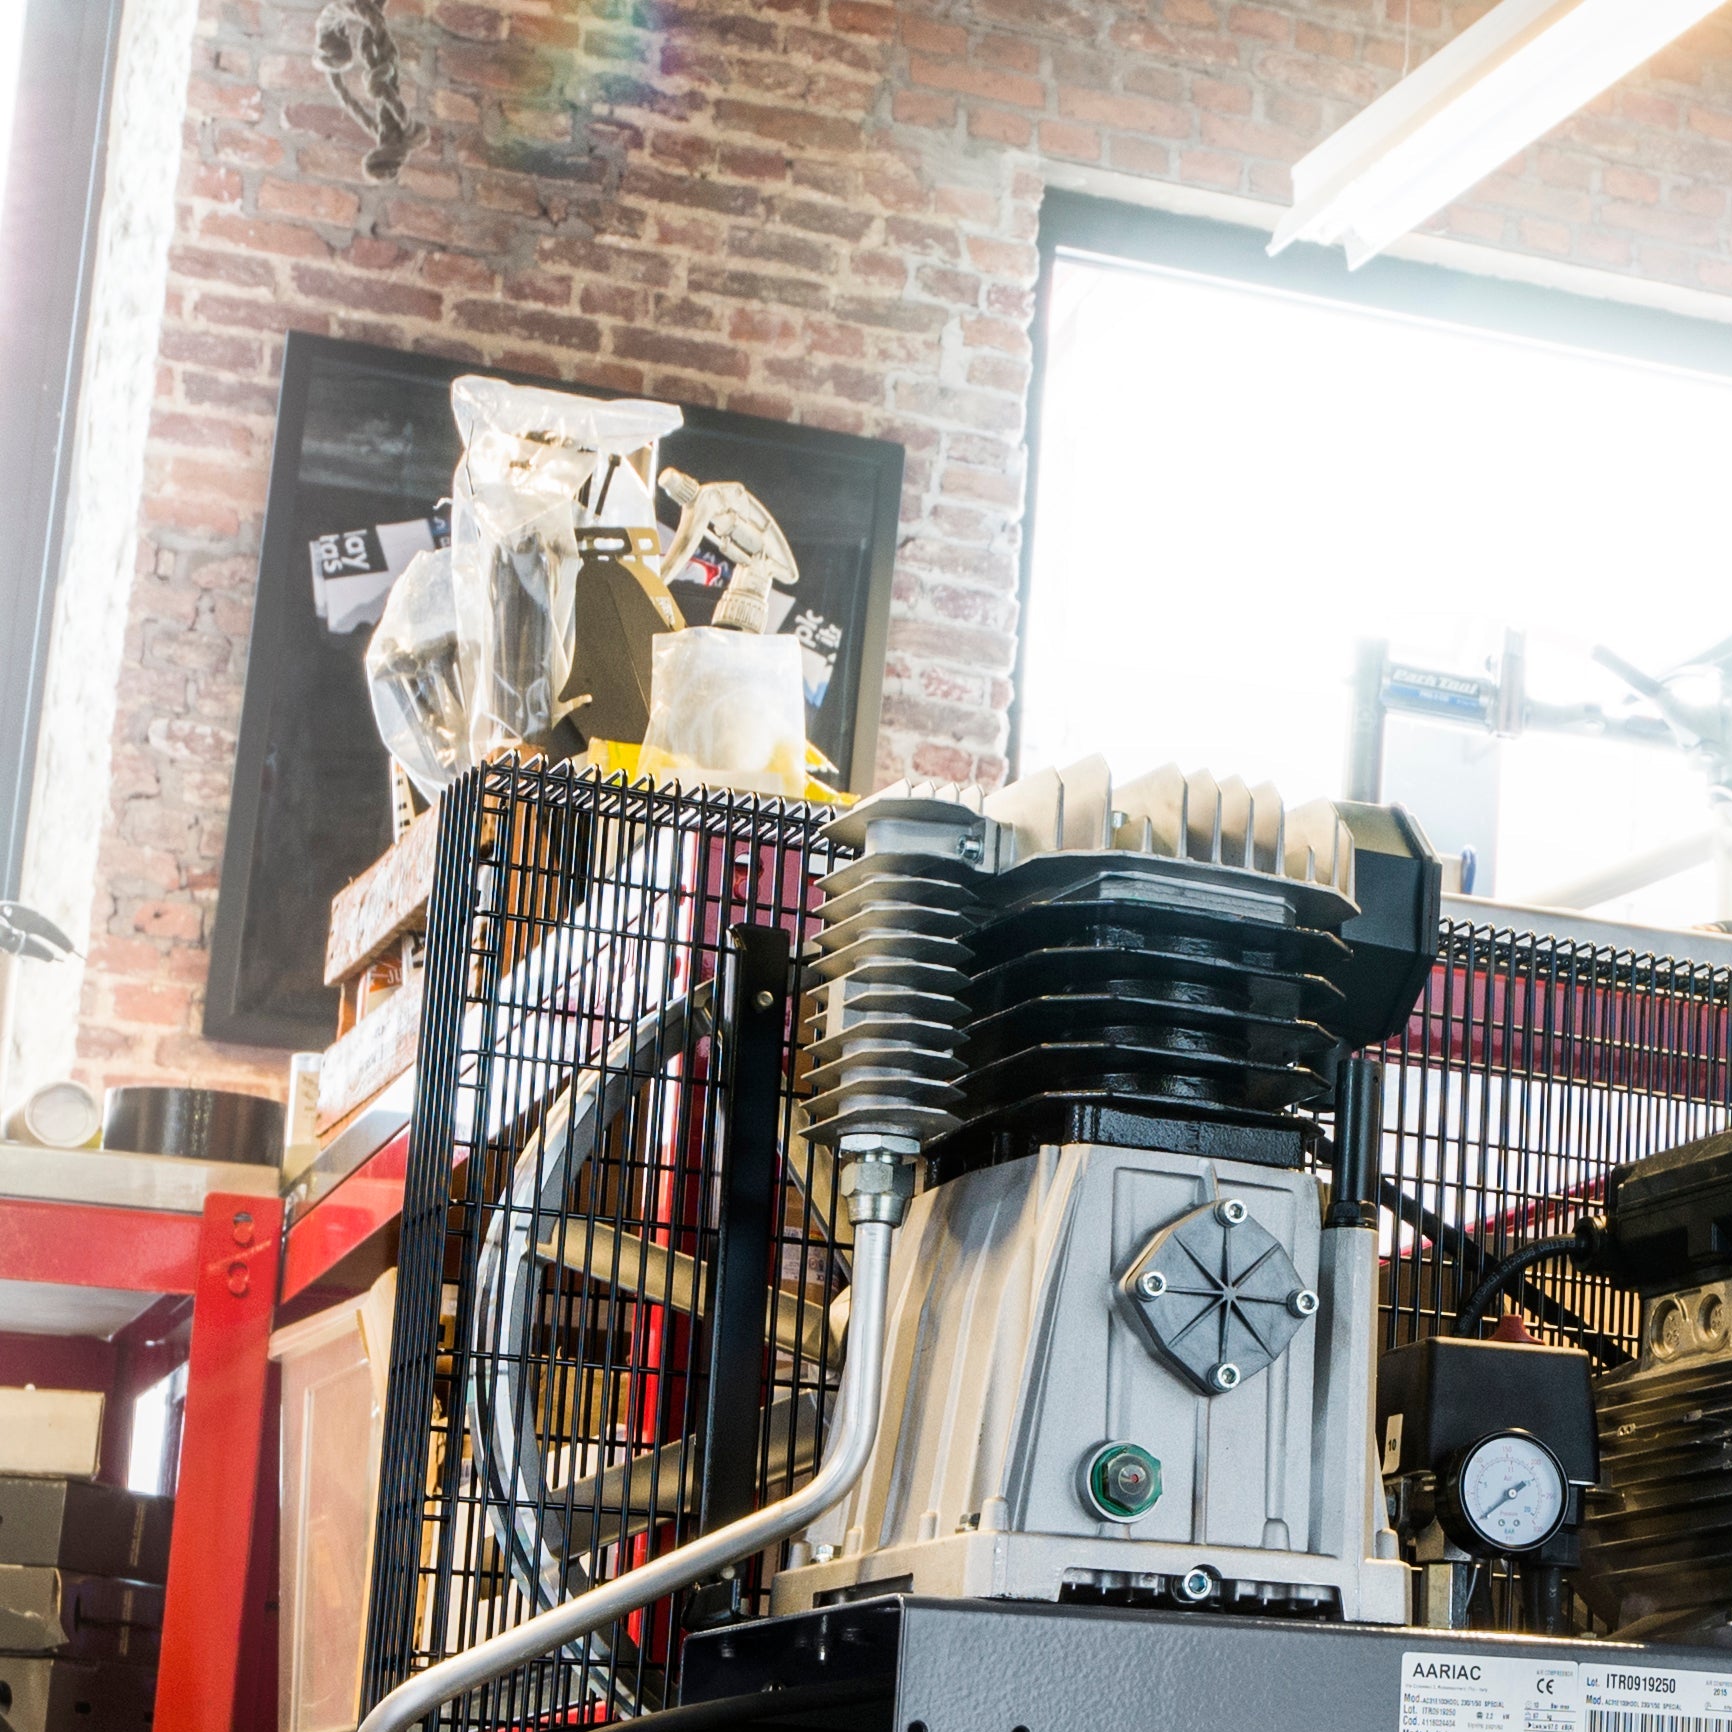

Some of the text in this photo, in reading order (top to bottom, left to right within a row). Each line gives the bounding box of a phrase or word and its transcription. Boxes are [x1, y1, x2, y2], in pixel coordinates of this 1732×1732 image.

[1388, 1438, 1397, 1451] 10
[1412, 1662, 1481, 1681] AARIAC
[1537, 1677, 1554, 1695] CE
[1606, 1673, 1676, 1694] ITR0919250
[1713, 1688, 1728, 1697] 2015
